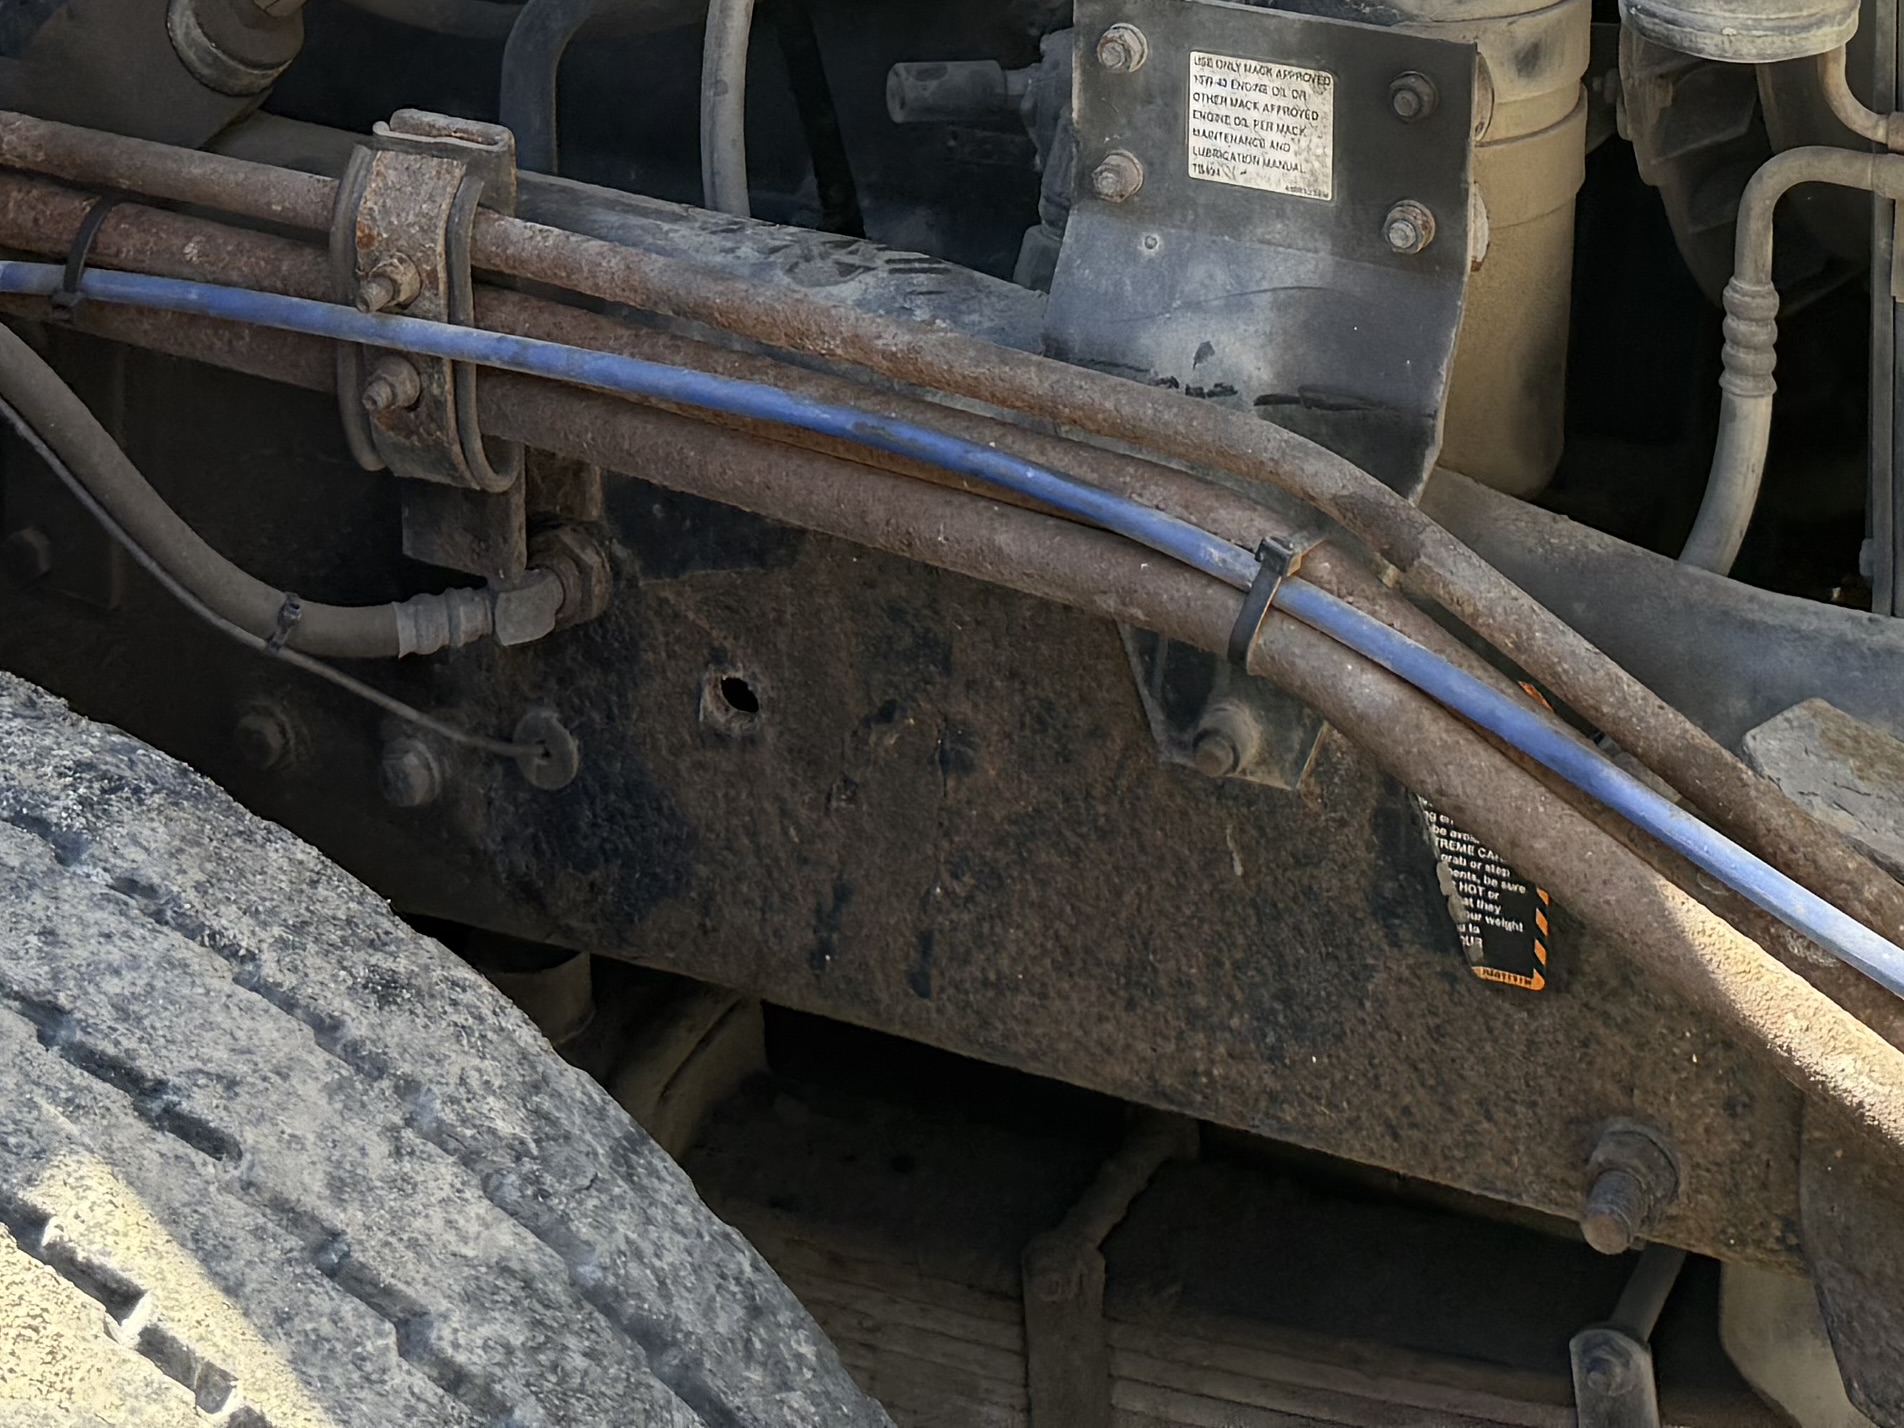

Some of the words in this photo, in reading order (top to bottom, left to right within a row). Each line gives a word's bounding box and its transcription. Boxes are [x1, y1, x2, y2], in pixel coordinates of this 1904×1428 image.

[1215, 58, 1242, 74] ONLY
[1275, 68, 1332, 87] APPROVED
[1192, 91, 1227, 105] OTHER
[1229, 97, 1261, 112] MACK
[1262, 102, 1320, 122] APPROVED
[1434, 836, 1476, 857] TREME
[1458, 883, 1485, 898] HOT
[1487, 890, 1500, 901] or
[1483, 873, 1498, 888] be
[1501, 880, 1526, 895] sure
[1477, 898, 1502, 916] they
[1465, 910, 1482, 922] our
[1485, 915, 1524, 934] weight
